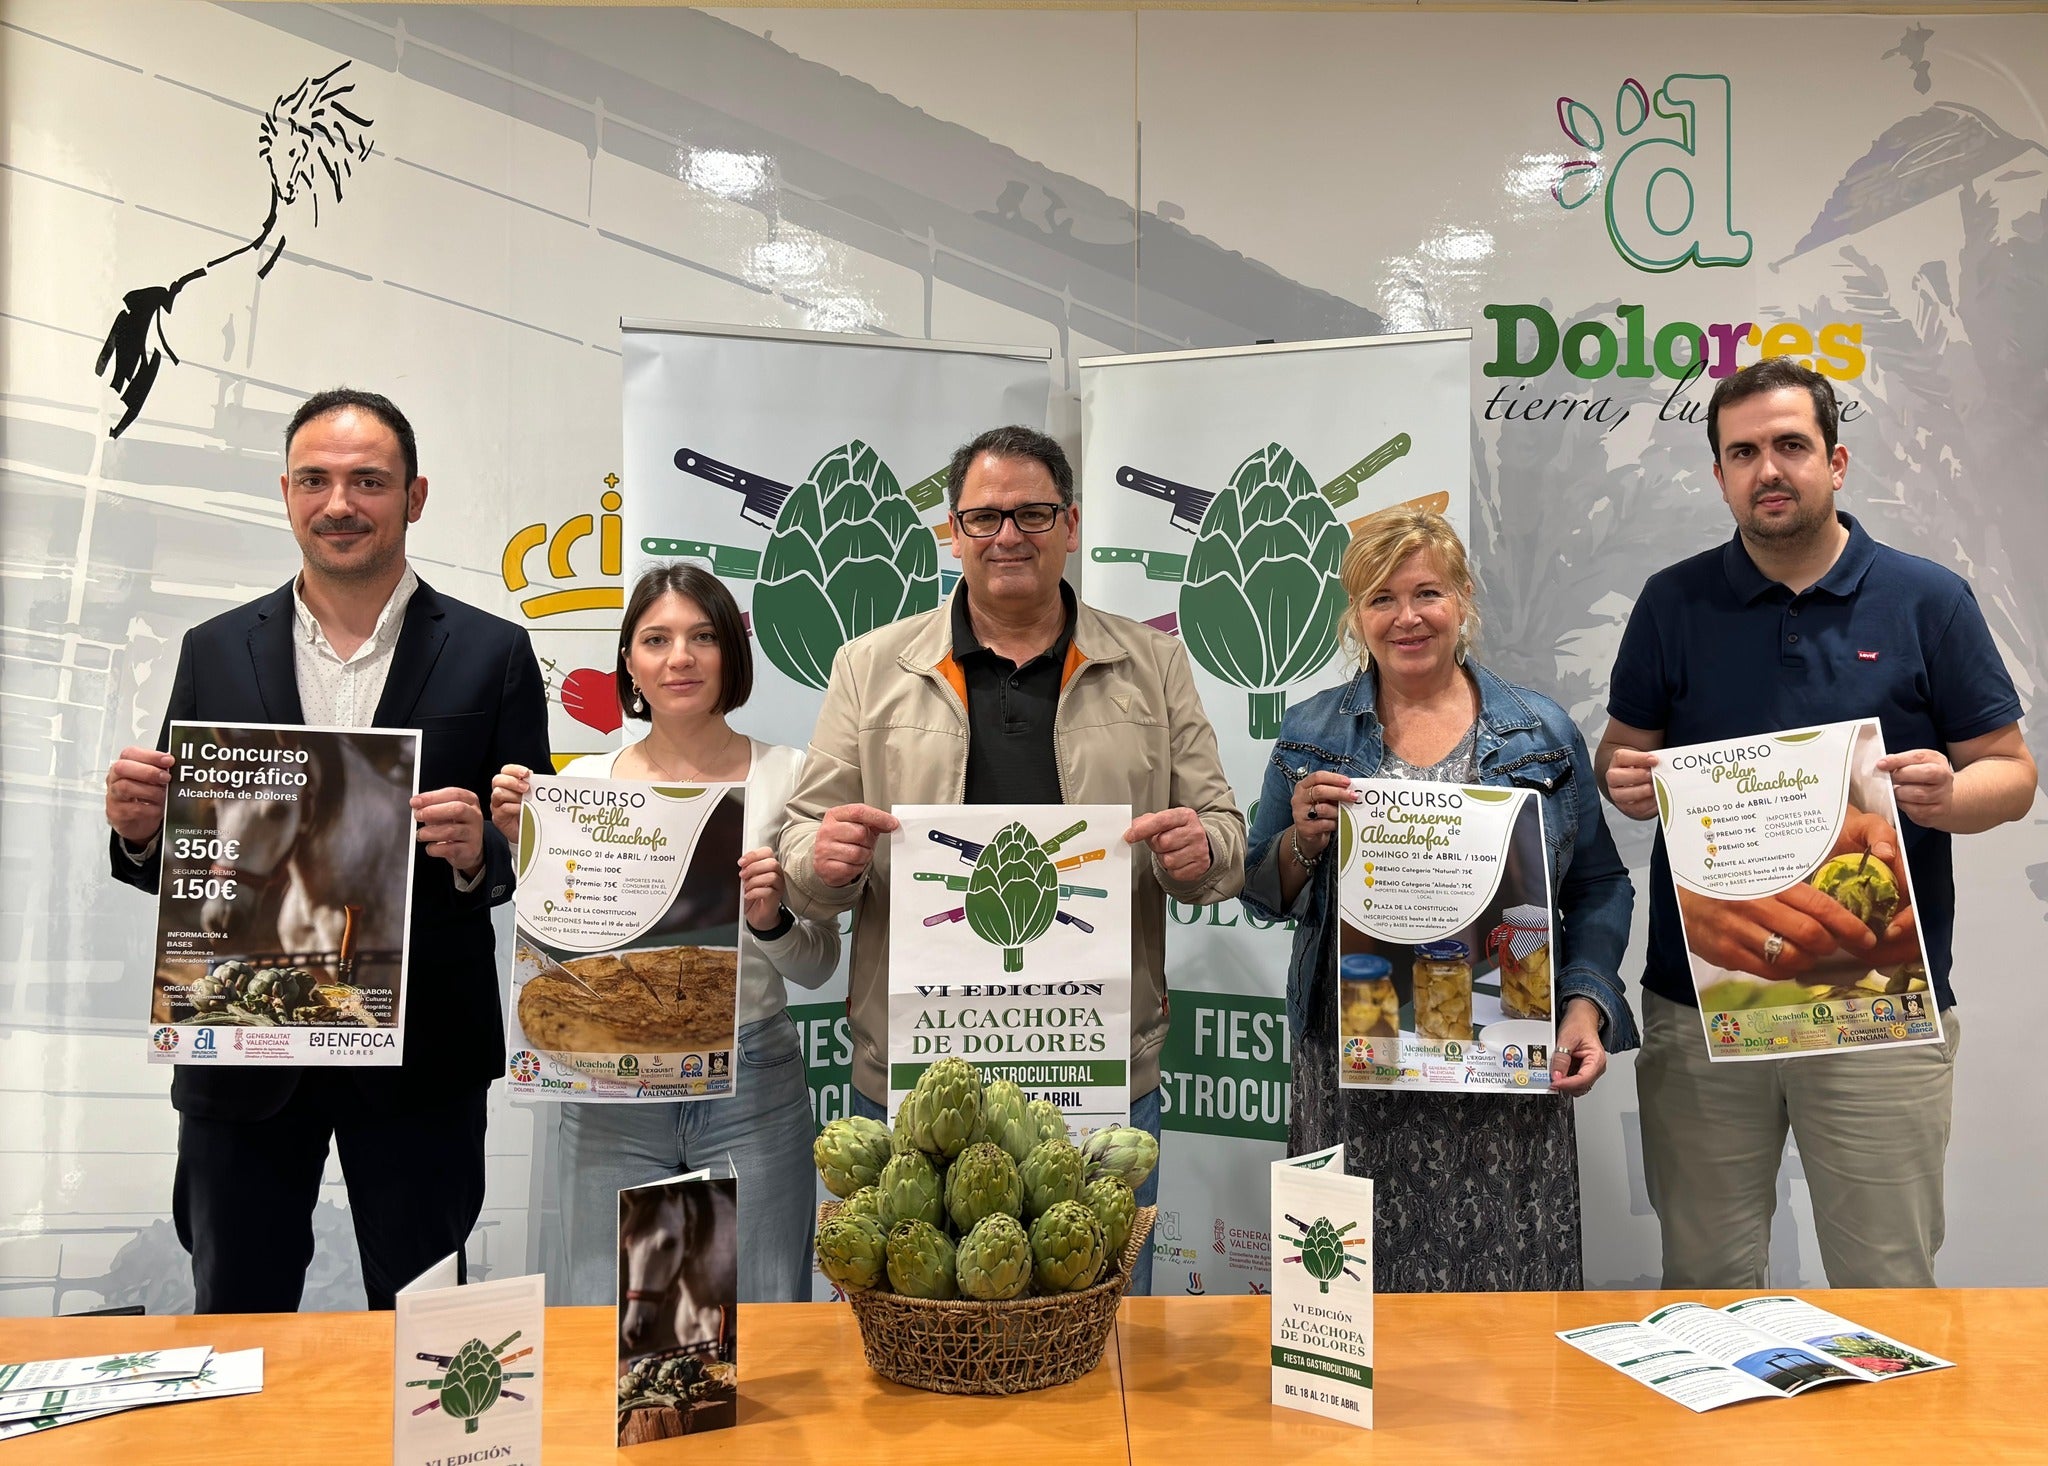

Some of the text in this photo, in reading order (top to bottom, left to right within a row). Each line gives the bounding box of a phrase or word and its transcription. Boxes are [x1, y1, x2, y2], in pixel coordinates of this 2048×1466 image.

[1483, 304, 1867, 381] Dolores
[1484, 359, 1718, 433] tierra, lu
[181, 743, 309, 764] II Concurso
[1673, 744, 1771, 771] CONCURSO
[179, 765, 308, 788] Fotográfico
[1701, 762, 1756, 784] de Pelar
[1736, 768, 1819, 794] Alcachofas
[178, 788, 298, 801] Alcachofa de Dolores
[536, 787, 646, 808] CONCURSO
[1354, 790, 1462, 808] CONCURSO
[1686, 804, 1721, 816] SÁBADO
[1722, 803, 1733, 811] 20
[1735, 800, 1745, 809] de
[1747, 797, 1772, 807] ABRIL
[555, 804, 630, 827] de Tortilla
[1370, 806, 1462, 826] de Conserva
[1712, 813, 1757, 824] PREMIO 100€
[1766, 809, 1822, 822] IMPORTES PARA
[175, 828, 202, 836] PRIMER
[1448, 826, 1461, 836] de
[1765, 820, 1804, 831] CONSUMIR
[1765, 825, 1830, 839] COMERCIO LOCAL
[581, 824, 667, 851] de Alcachofa
[1361, 825, 1450, 851] Alcachofas
[1716, 829, 1743, 838] PREMIO
[174, 838, 240, 860] 350€
[549, 848, 592, 858] DOMINGO
[605, 851, 614, 860] de
[617, 852, 641, 861] ABRIL
[1362, 850, 1409, 859] DOMINGO
[1718, 843, 1745, 851] PREMIO
[1714, 860, 1737, 868] FRENTE
[1747, 853, 1795, 864] AYUNTAMIENTO
[605, 866, 622, 874] 100€
[1703, 870, 1752, 881] INSCRIPCIONES
[1753, 867, 1770, 875] hasta
[171, 878, 238, 900] 150€
[575, 893, 601, 901] Premio:
[533, 915, 581, 924] INSCRIPCIONES
[592, 908, 637, 916] CONSTITUCIÓN
[167, 931, 221, 939] INFORMACIÓN
[914, 981, 1105, 998] VI EDICIÓN
[914, 1007, 1104, 1029] ALCACHOFA
[1195, 1007, 1291, 1064] FIEST
[1843, 1033, 1889, 1043] VALENCIANA
[1850, 1027, 1887, 1036] COMUNITAT
[327, 1033, 395, 1047] ENFOCA
[912, 1033, 1106, 1054] DE DOLORES
[1744, 1036, 1789, 1047] Dolores
[1376, 1066, 1420, 1077] Dolores
[541, 1078, 588, 1090] Dolores
[1470, 1077, 1512, 1085] VALENCIANA
[642, 1089, 689, 1097] VALENCIANA
[1043, 1092, 1083, 1107] ABRIL
[1229, 1228, 1272, 1241] GENERAL
[1230, 1239, 1272, 1252] VALENCI
[1293, 1303, 1353, 1323] VI EDICIÓN
[1281, 1317, 1365, 1344] ALCACHOFA
[1280, 1330, 1366, 1358] DE DOLORES
[1283, 1352, 1362, 1380] FIESTA GASTROCULTURAL
[1285, 1383, 1361, 1412] DEL 18 AL 21 DE ABRIL
[446, 1446, 512, 1466] EDICIÓN
